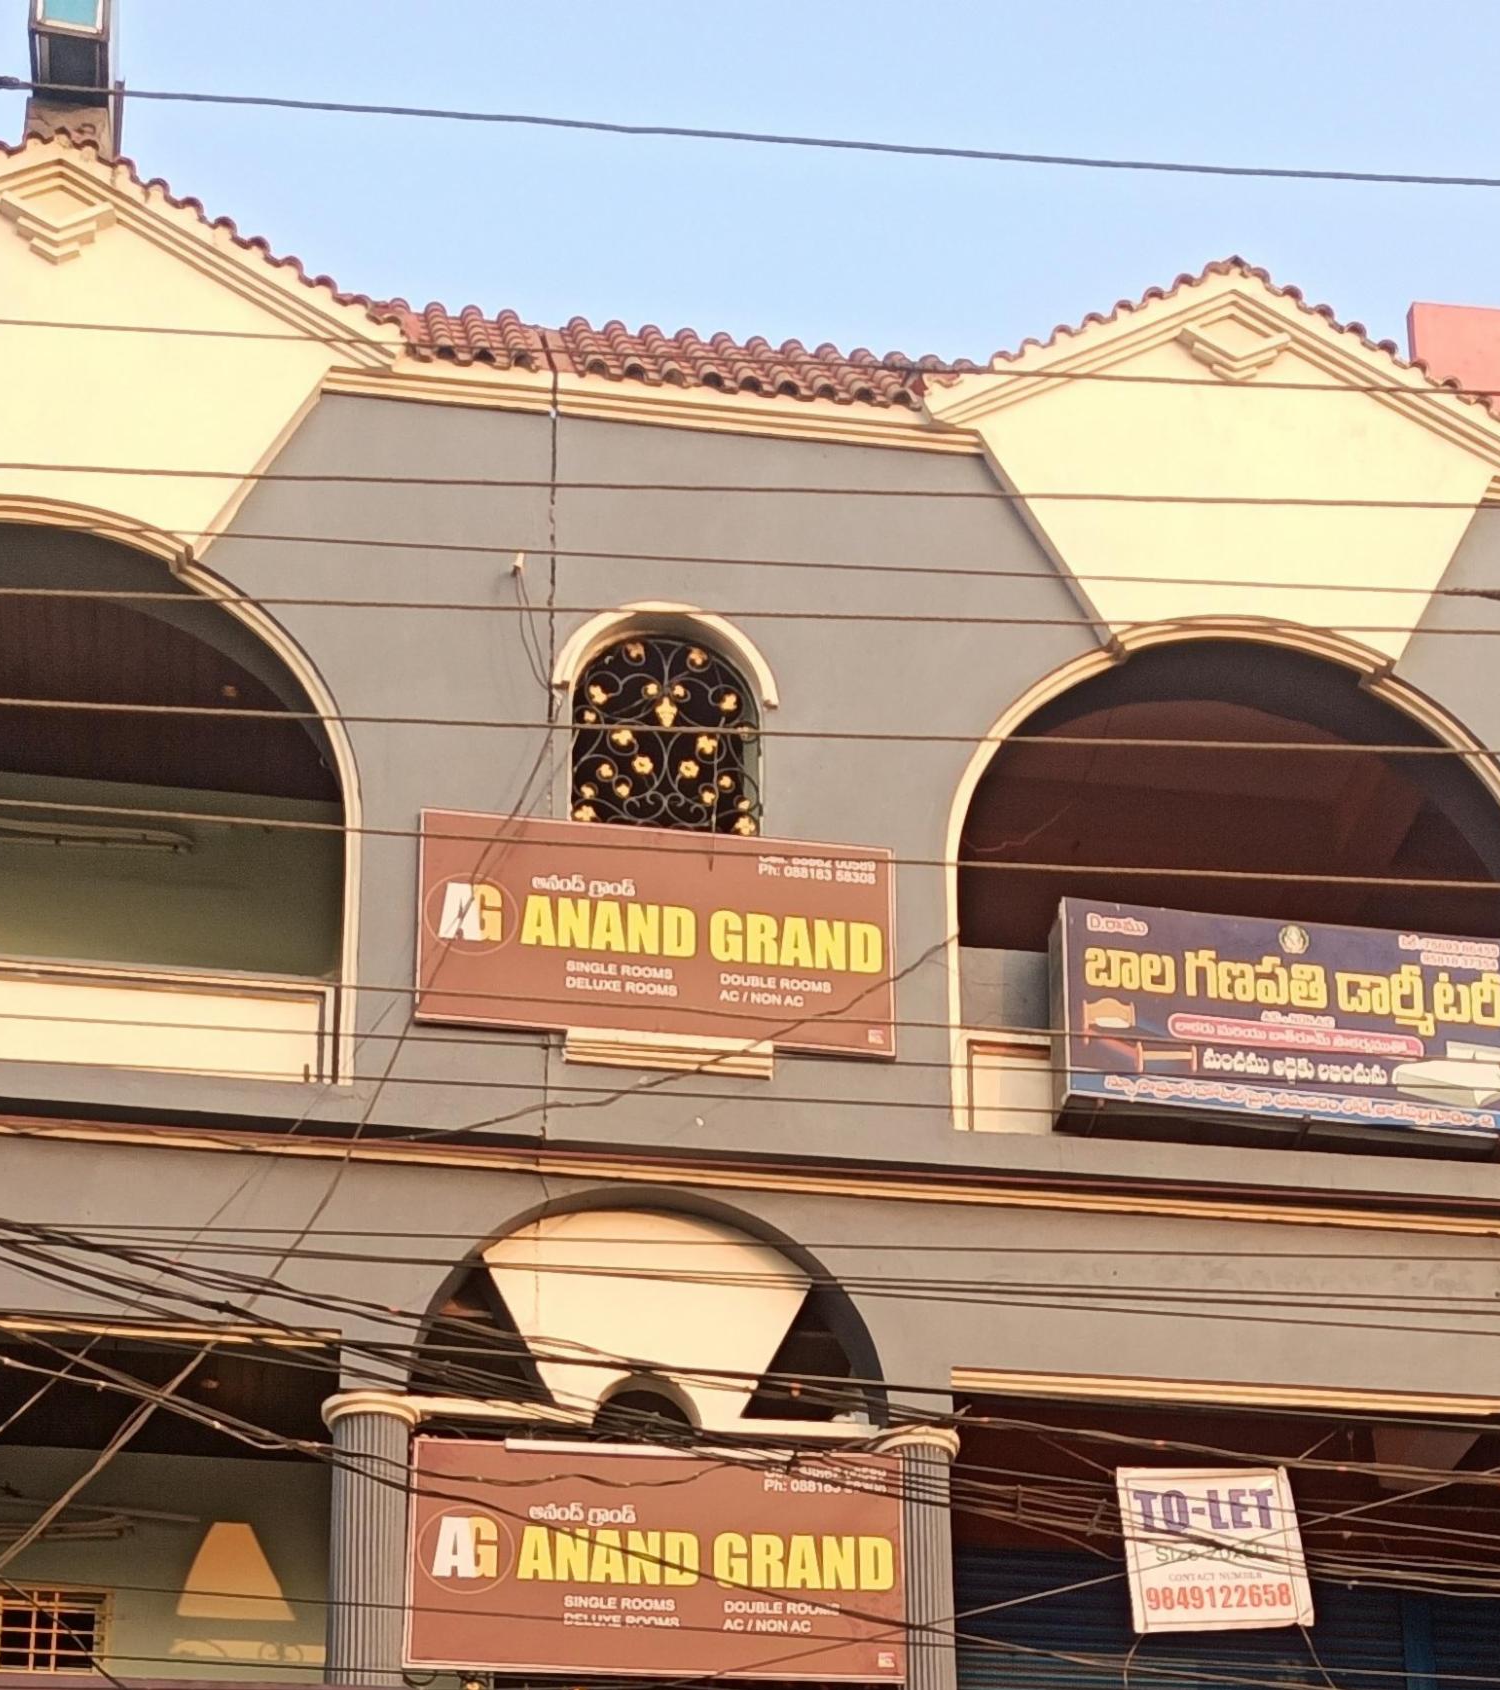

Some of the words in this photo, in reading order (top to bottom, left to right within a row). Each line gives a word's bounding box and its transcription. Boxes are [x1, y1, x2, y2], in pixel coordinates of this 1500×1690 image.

[521, 895, 696, 958] ANAND
[710, 910, 883, 974] GRAND
[566, 960, 617, 976] SINGLE
[621, 966, 673, 981] ROOMS
[1085, 947, 1176, 994] బాల
[1184, 949, 1328, 1010] గణపతి
[566, 976, 622, 993] DELUXE
[625, 981, 678, 998] ROOMS
[720, 973, 777, 992] DOUBLE
[780, 979, 832, 995] ROOMS
[1133, 1488, 1273, 1533] TO-LET
[516, 1526, 699, 1588] ANAND
[713, 1531, 893, 1591] GRAND
[564, 1595, 617, 1611] SINGLE
[621, 1597, 675, 1612] ROOMS
[723, 1600, 782, 1615] DOUBLE
[1146, 1582, 1292, 1611] 9849122658
